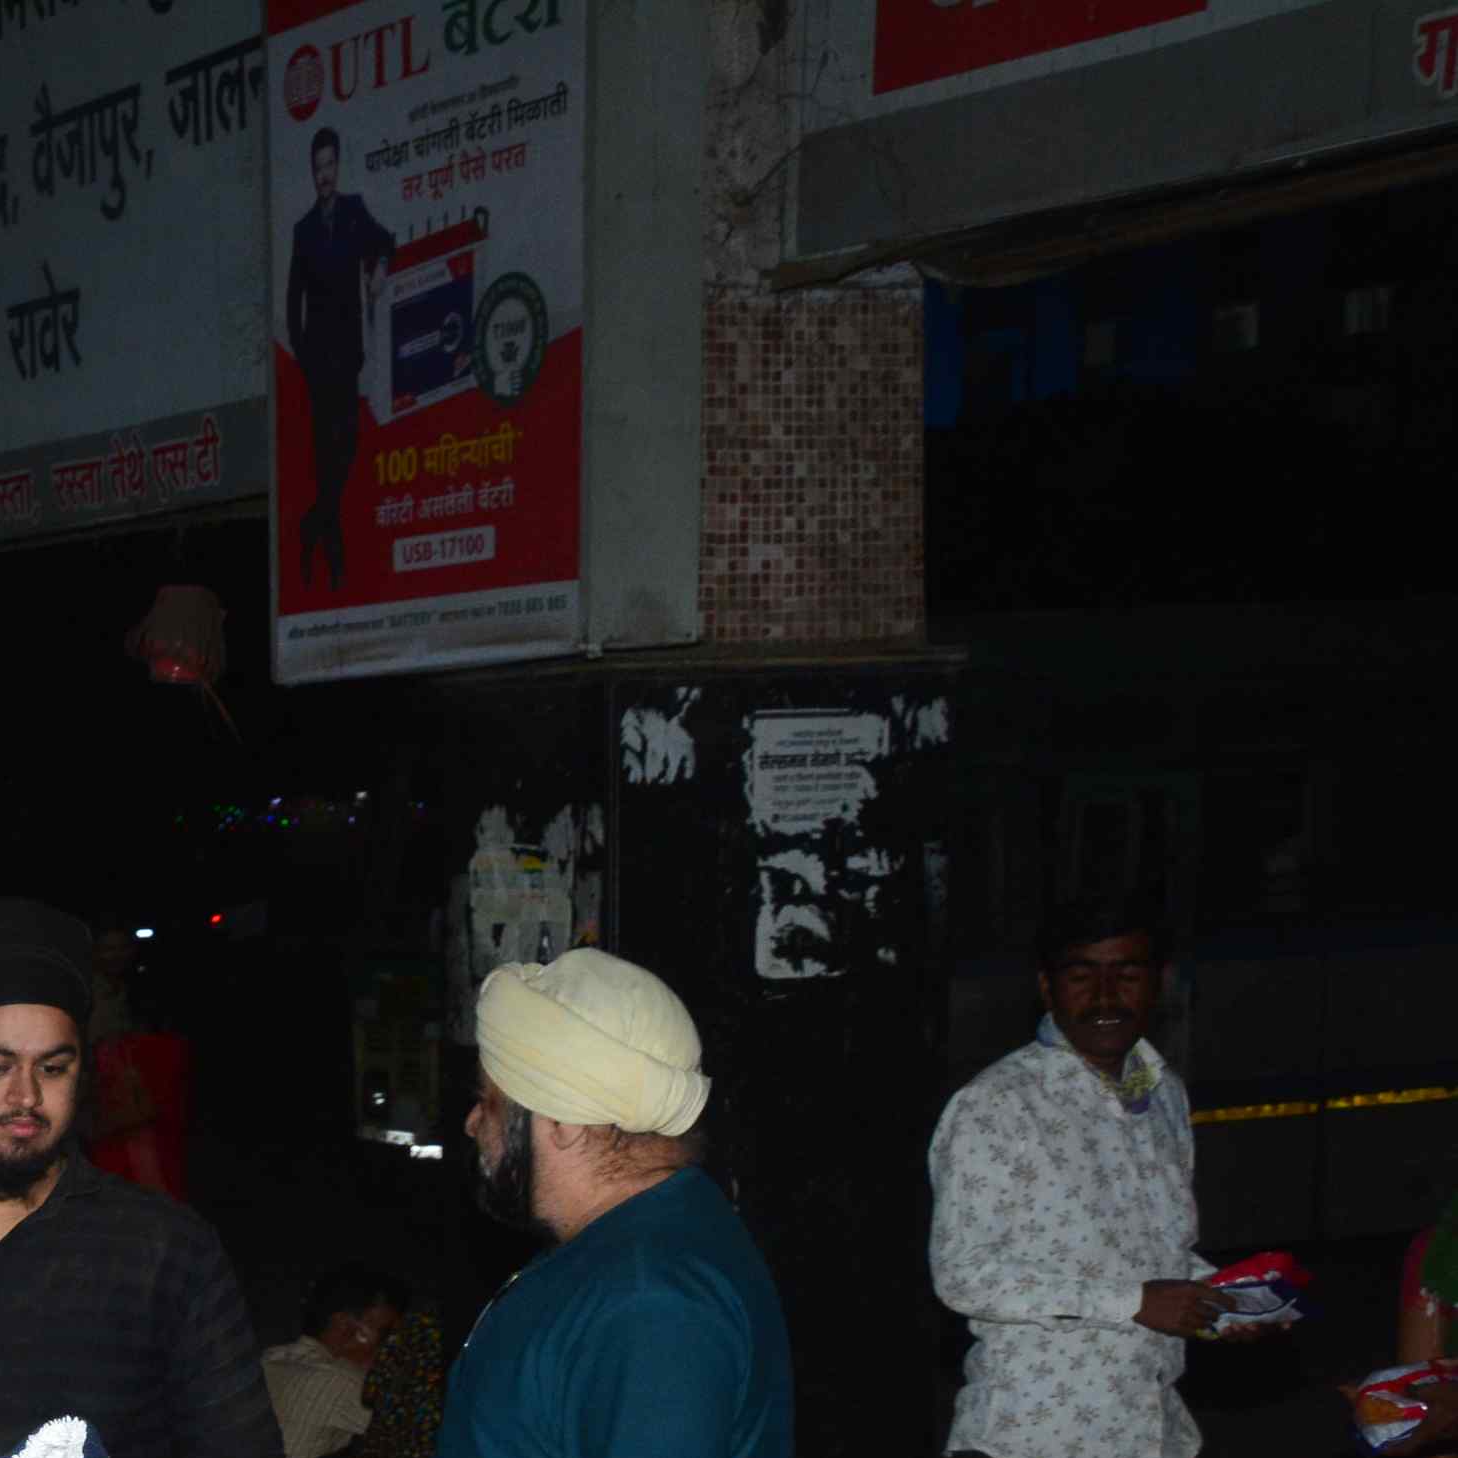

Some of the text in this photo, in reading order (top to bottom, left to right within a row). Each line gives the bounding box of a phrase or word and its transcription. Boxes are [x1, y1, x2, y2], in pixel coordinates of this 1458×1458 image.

[331, 16, 430, 102] UTL
[29, 80, 154, 220] वैजापुर,
[458, 146, 486, 184] पैसे
[491, 143, 528, 171] परत
[6, 259, 83, 381] रावेर
[373, 447, 418, 487] 100
